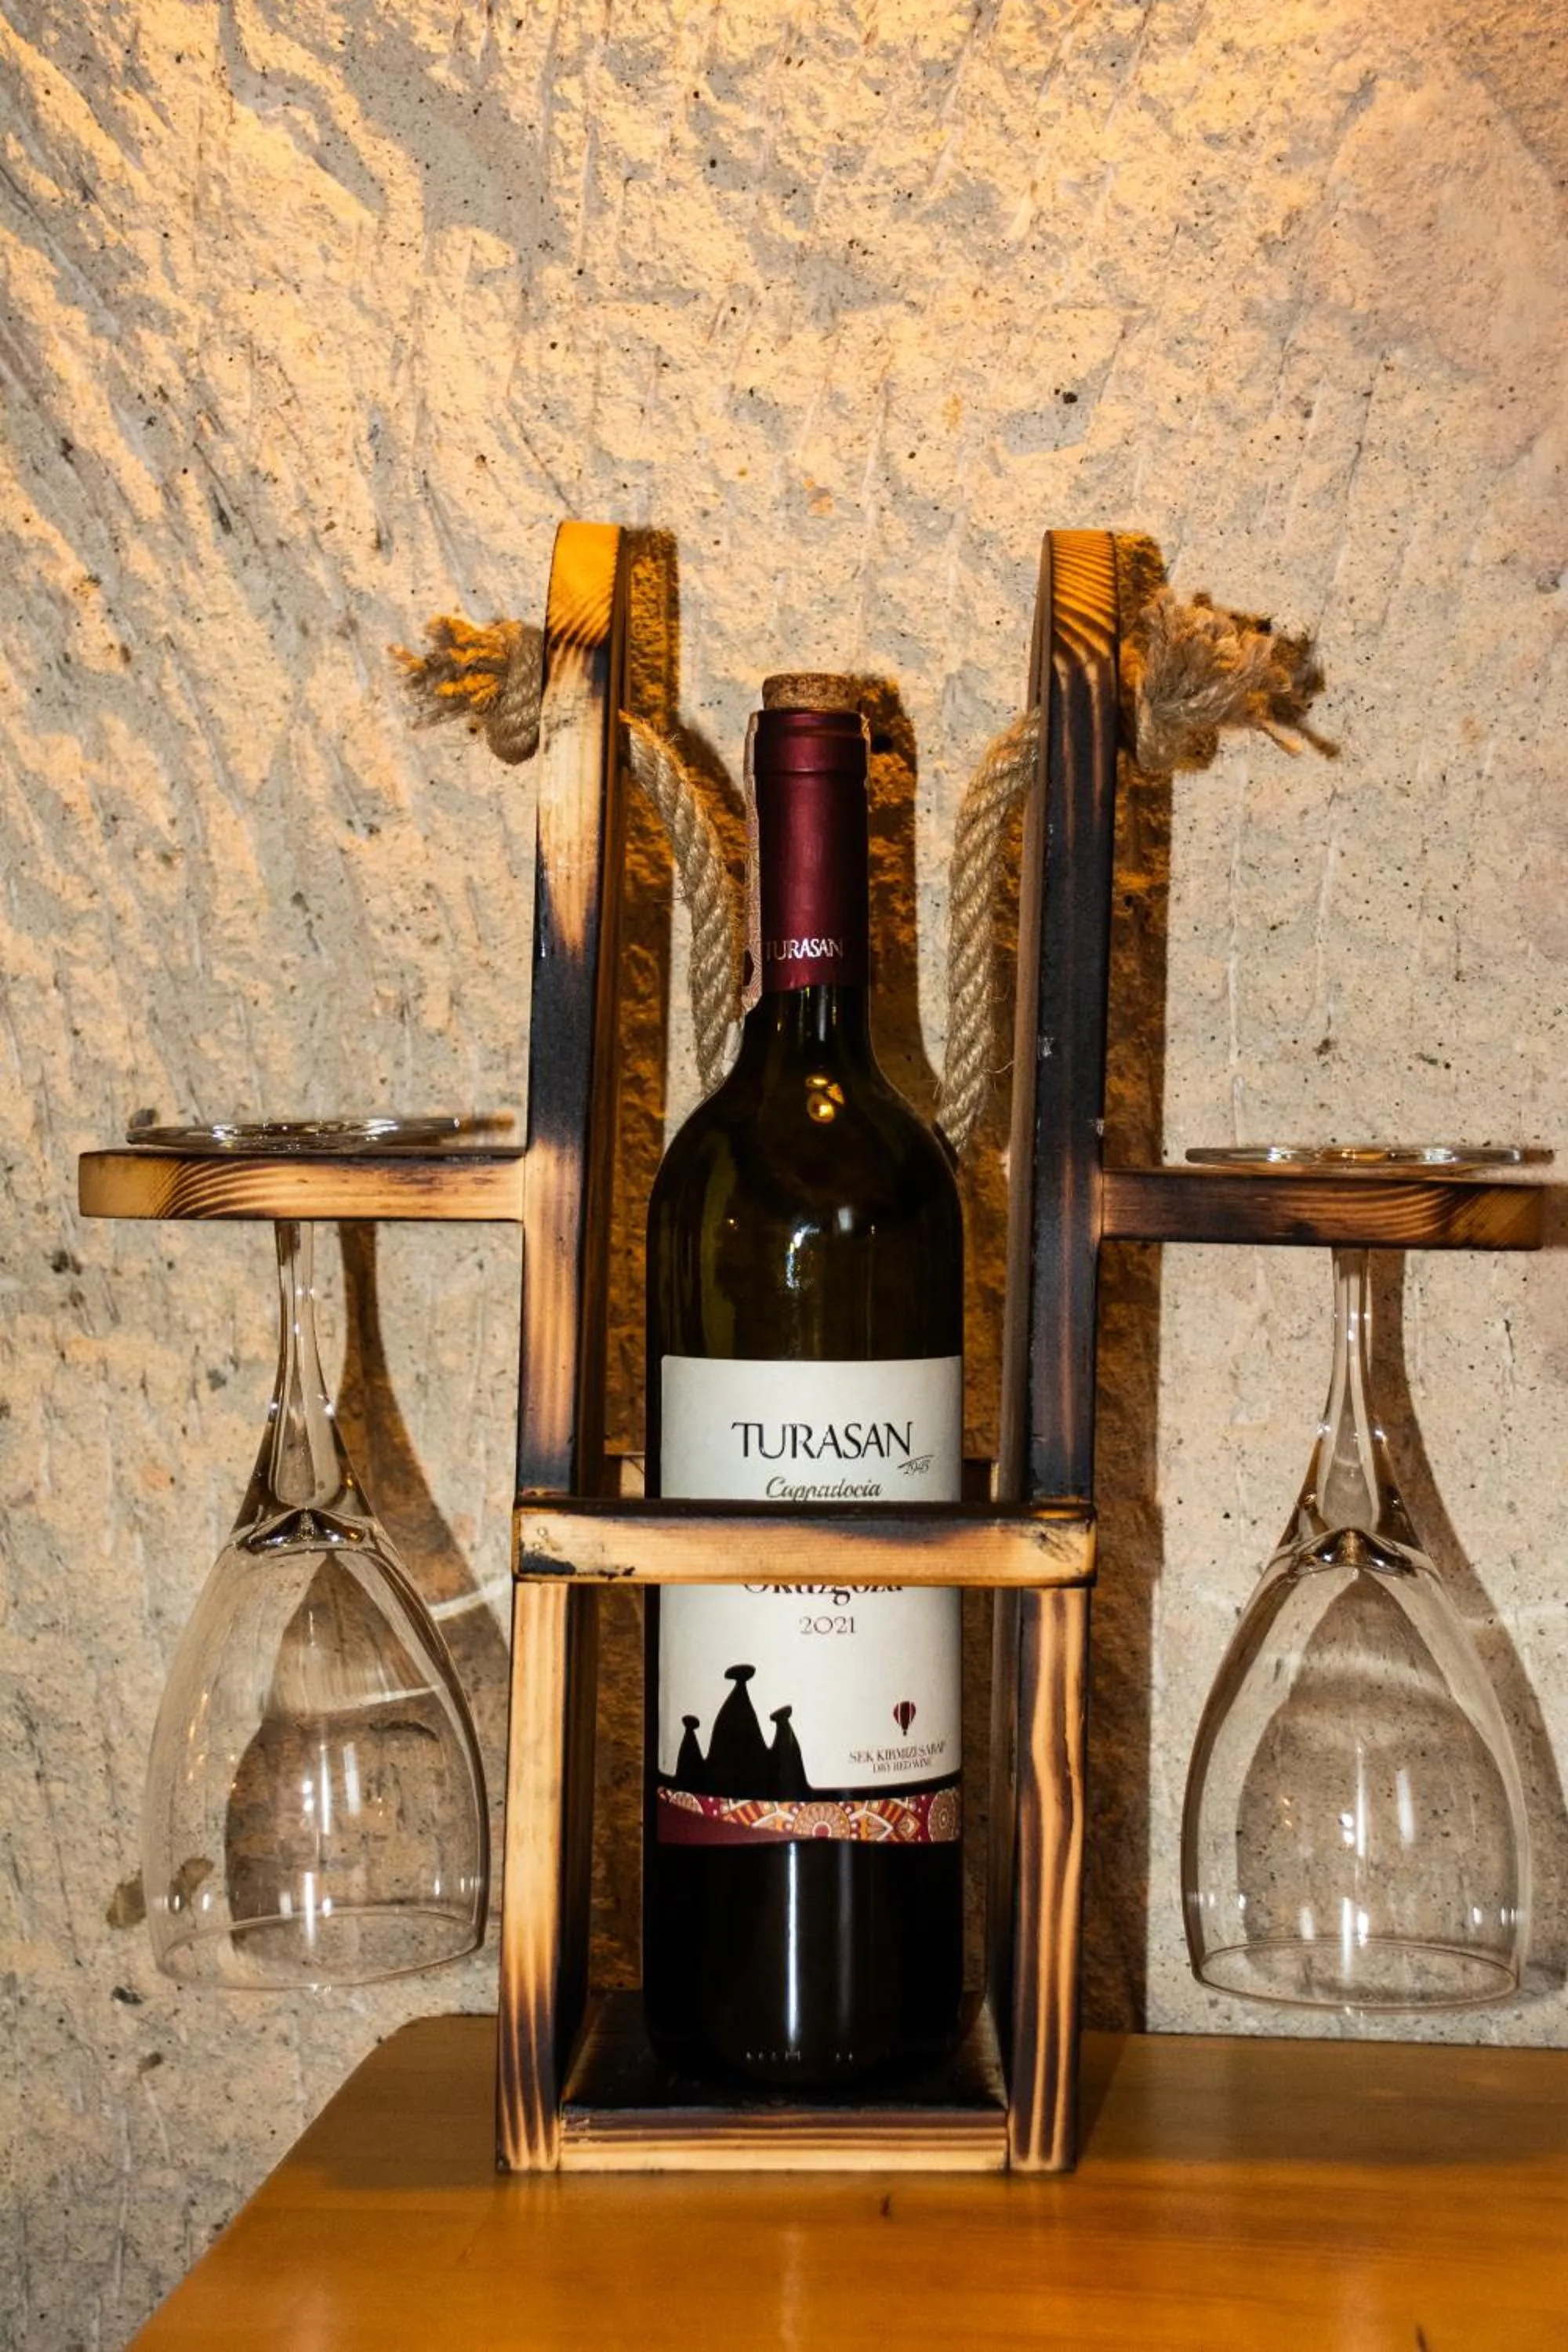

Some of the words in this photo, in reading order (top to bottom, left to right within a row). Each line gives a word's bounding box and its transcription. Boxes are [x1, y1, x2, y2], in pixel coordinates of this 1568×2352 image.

[765, 938, 844, 960] TURASAN
[731, 1421, 913, 1459] TURASAN
[765, 1475, 883, 1501] Cappadocia
[799, 1615, 857, 1635] 2021
